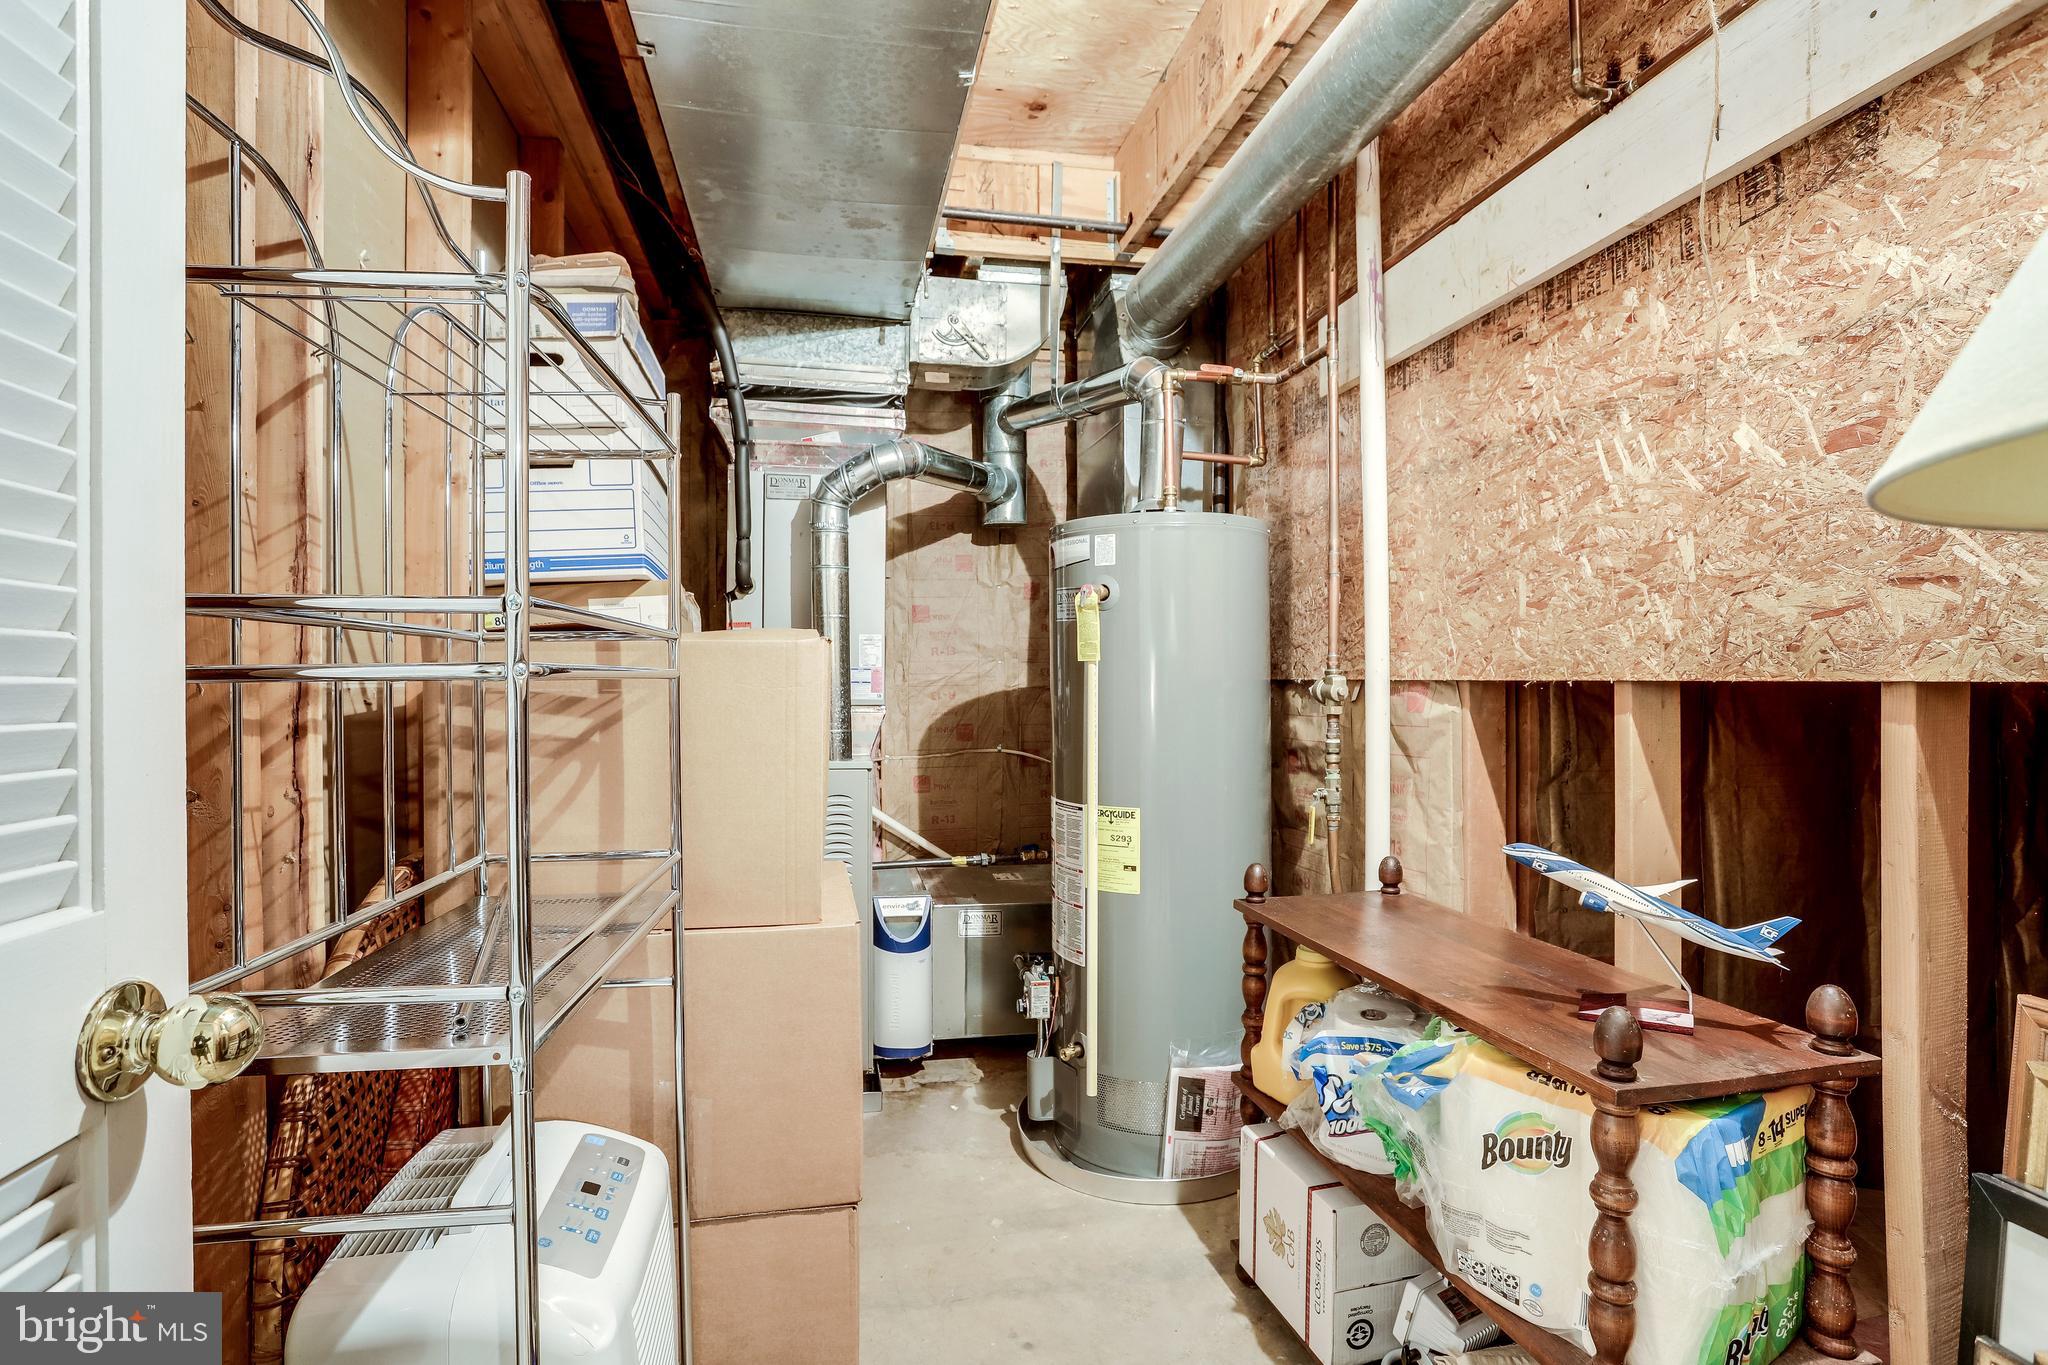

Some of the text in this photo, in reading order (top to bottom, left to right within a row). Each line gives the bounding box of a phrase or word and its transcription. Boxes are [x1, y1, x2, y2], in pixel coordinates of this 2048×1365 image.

[931, 815, 956, 825] R-13
[962, 914, 999, 924] DONMAR
[1760, 925, 1780, 940] ICF
[1341, 1041, 1360, 1050] Save
[1482, 1130, 1573, 1170] Bounty
